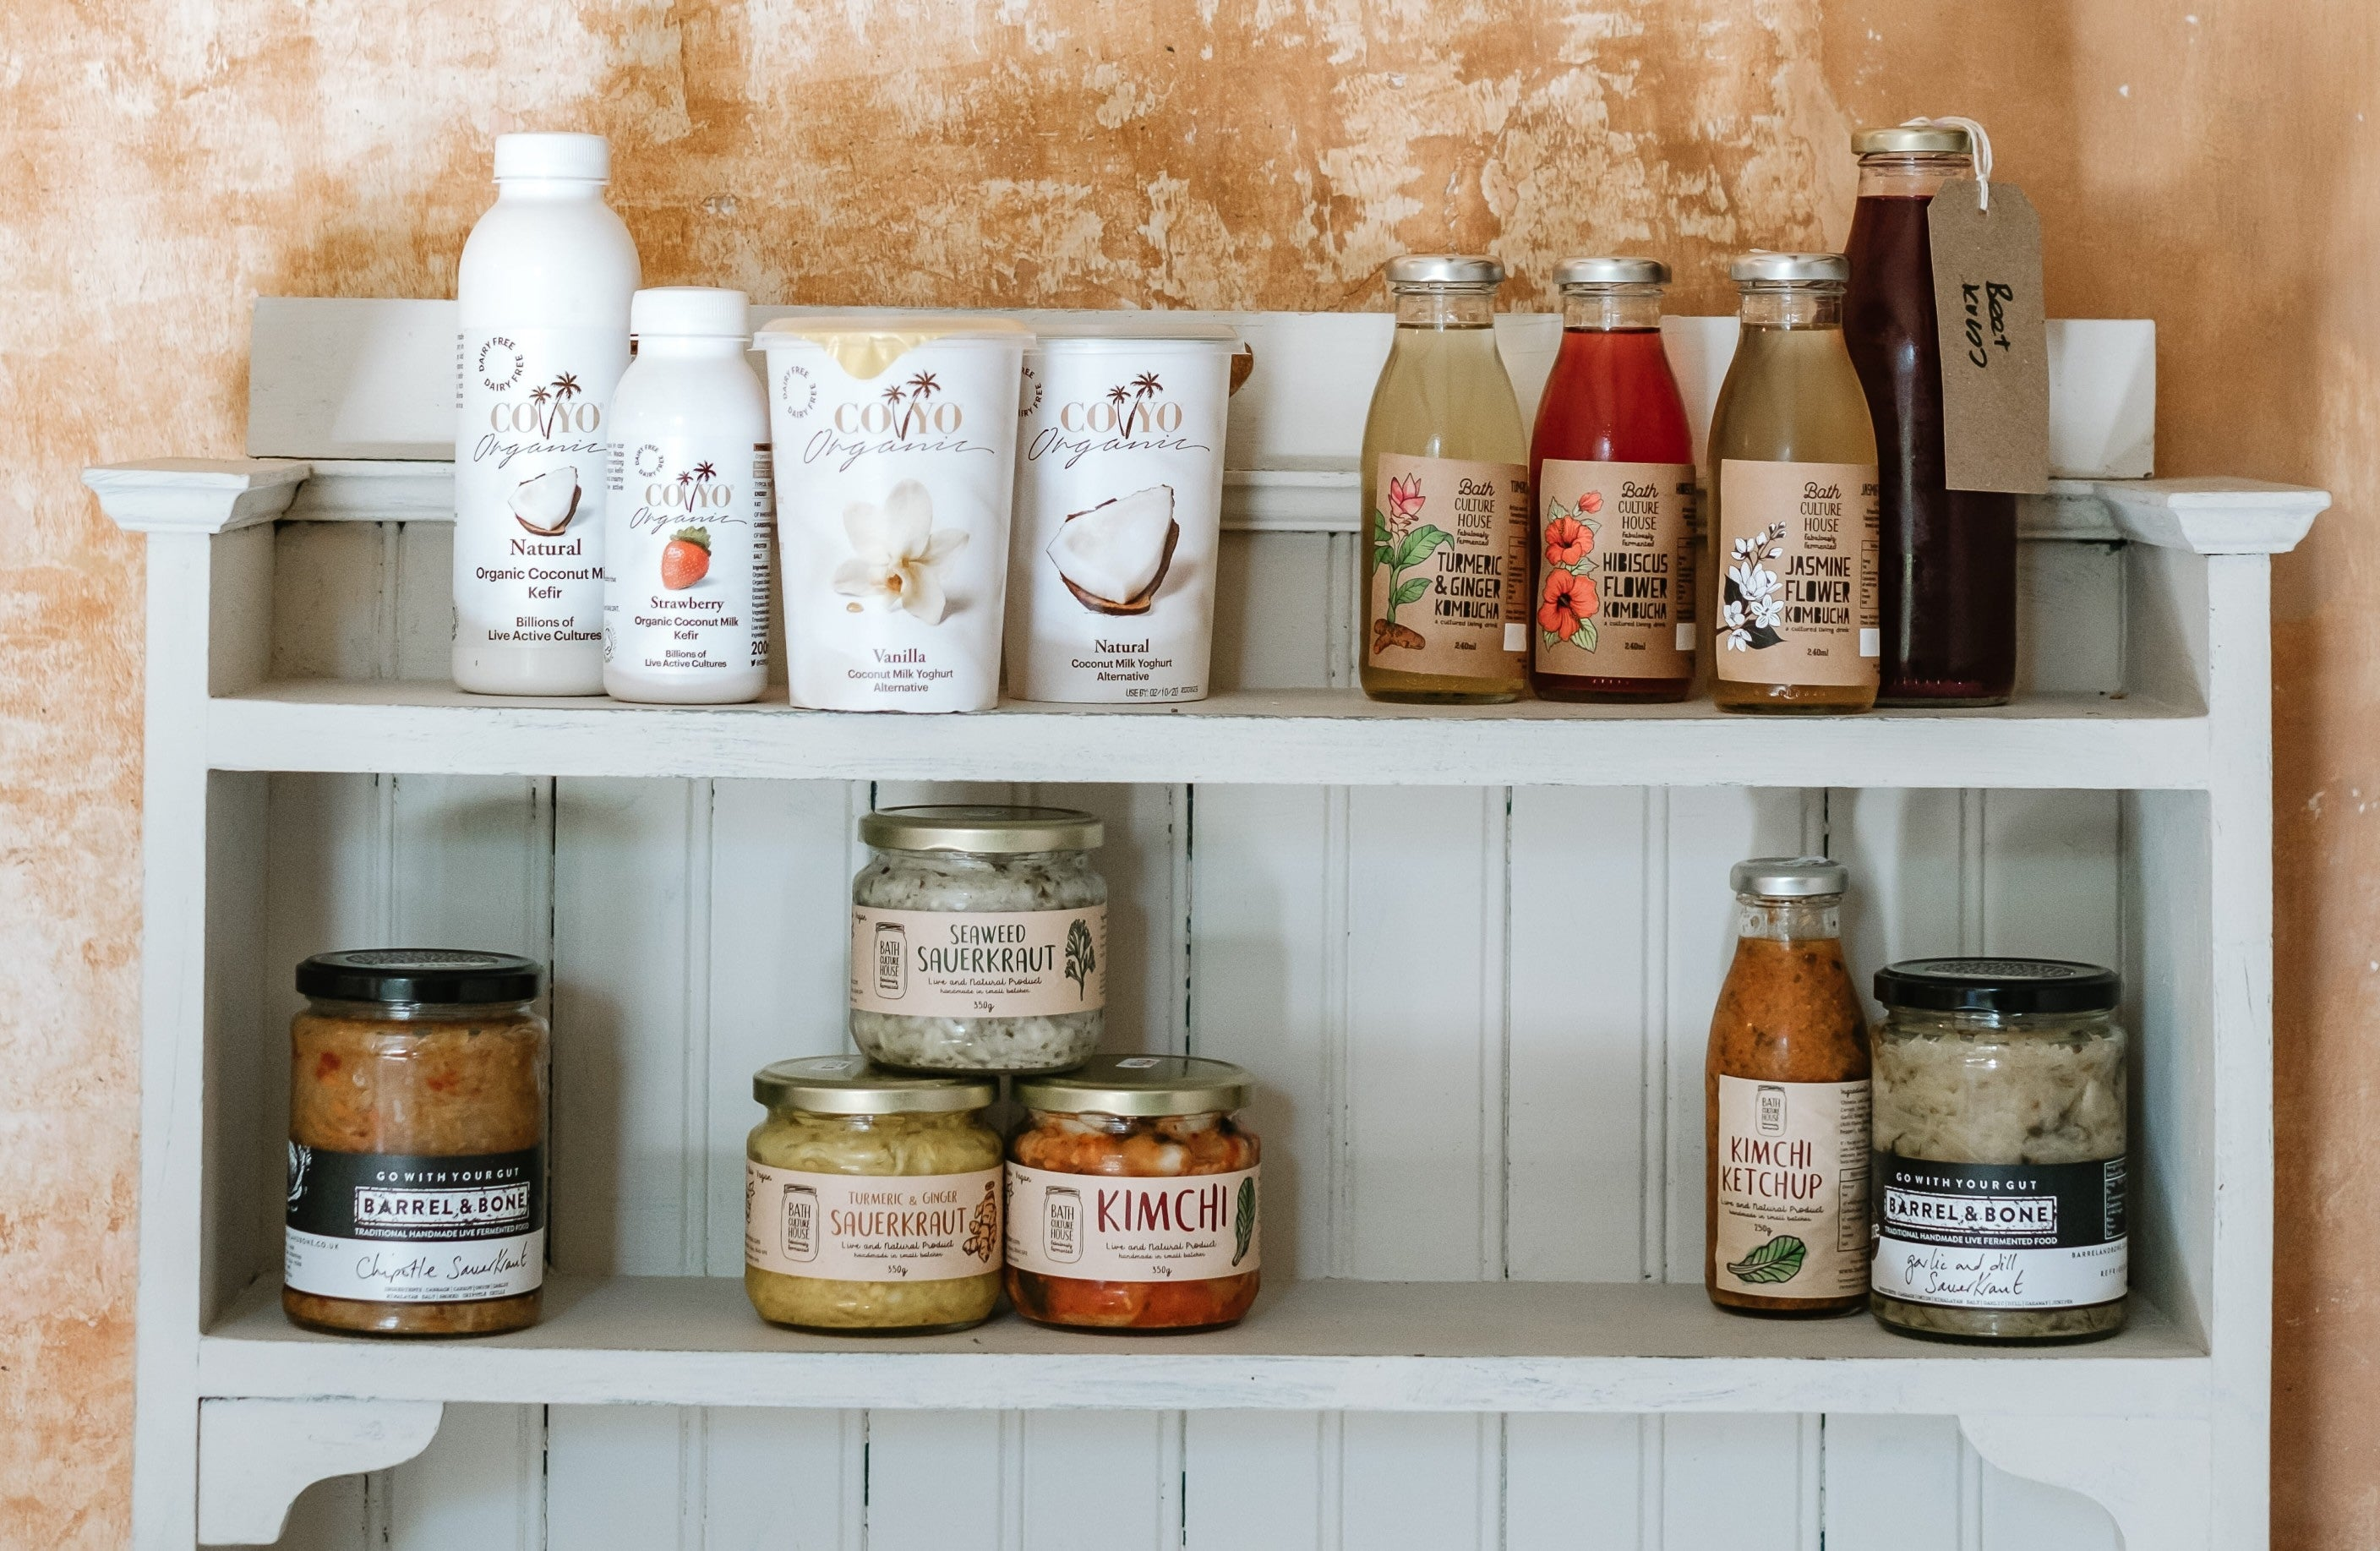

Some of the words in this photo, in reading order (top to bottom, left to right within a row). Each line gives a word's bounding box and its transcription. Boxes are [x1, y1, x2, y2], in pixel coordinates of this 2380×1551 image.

[478, 340, 491, 372] DAIRY
[493, 336, 516, 351] FREE
[484, 378, 511, 391] DAIRY
[510, 354, 523, 382] FREE
[1021, 367, 1035, 380] REE
[783, 372, 791, 400] DAIRY
[792, 366, 810, 380] FREE
[1033, 382, 1043, 409] FREE
[788, 406, 808, 419] DAIRY
[473, 433, 607, 469] Organic
[804, 429, 995, 472] Organic
[1028, 427, 1210, 469] Organic
[1458, 478, 1495, 496] Bath
[1622, 481, 1659, 498] Bath
[1804, 482, 1842, 500] Bath
[1455, 497, 1495, 513] CULTURE
[1619, 500, 1659, 514] CULTURE
[1800, 502, 1842, 516] CULTURE
[630, 506, 747, 534] Organic
[1457, 513, 1492, 529] HOUSE
[1622, 516, 1657, 530] HOUSE
[1804, 517, 1839, 532] HOUSE
[510, 538, 581, 555] Natural
[1438, 551, 1502, 576] TURMERIC
[1603, 552, 1668, 573] HIBISCUS
[1785, 555, 1851, 577] JASMINE
[476, 567, 525, 582] Organic
[528, 567, 588, 580] Coconut
[528, 587, 562, 598] Kefir
[1434, 575, 1447, 595] &
[1450, 576, 1501, 598] GINGER
[1604, 576, 1668, 598] FLOWER
[1785, 580, 1850, 603] FLOWER
[651, 596, 724, 613] Strawberry
[1434, 598, 1499, 620] KOMBUCHA
[1604, 602, 1667, 620] KOMBUCHA
[516, 616, 560, 627] Billions
[562, 616, 574, 627] of
[635, 616, 673, 628] Organic
[674, 617, 718, 626] Coconut
[720, 617, 739, 626] Milk
[1785, 606, 1849, 625] KOMBUCHA
[489, 630, 510, 641] Live
[512, 630, 551, 641] Active
[554, 631, 602, 641] Cultures
[674, 631, 699, 640] Kefir
[1094, 638, 1149, 653] Natural
[1455, 642, 1477, 650] 240ml
[665, 650, 696, 658] Billions
[697, 650, 707, 658] of
[873, 648, 926, 664] Vanilla
[663, 659, 691, 668] Active
[691, 659, 727, 668] Cultures
[1071, 658, 1113, 669] Coconut
[1116, 658, 1136, 668] Milk
[1138, 658, 1173, 669] Yoghurt
[848, 669, 891, 680] Coconut
[892, 669, 914, 679] Milk
[916, 669, 953, 680] Yoghurt
[1097, 671, 1149, 681] Alternative
[874, 682, 929, 692] Alternative
[1126, 687, 1138, 696] USE
[951, 924, 1026, 945] SEAWEED
[880, 941, 900, 956] BATH
[880, 956, 899, 965] CULTURE
[917, 944, 1056, 973] SAUERKRAUT
[880, 965, 899, 976] HOUSE
[928, 977, 947, 986] Live
[969, 977, 1006, 986] Natural
[1008, 976, 1043, 986] Product
[974, 1001, 995, 1013] 350g
[1762, 1097, 1781, 1107] BATH
[1732, 1135, 1811, 1170] KIMCHI
[376, 1171, 397, 1182] GO
[405, 1171, 446, 1182] WITH
[452, 1169, 492, 1182] YOUR
[497, 1167, 519, 1179] GUT
[1896, 1172, 1911, 1182] GO
[1915, 1175, 1950, 1188] WITH
[1956, 1179, 2000, 1190] YOUR
[2006, 1180, 2037, 1190] GUT
[1722, 1166, 1822, 1199] KETCHUP
[364, 1197, 453, 1215] BARREL
[460, 1199, 472, 1215] &
[478, 1192, 527, 1214] BONE
[848, 1191, 903, 1205] TURMERIC
[909, 1194, 917, 1205] &
[922, 1190, 958, 1204] GINGER
[789, 1202, 811, 1218] BATH
[1051, 1204, 1074, 1220] BATH
[1098, 1183, 1227, 1232] KIMCHI
[1753, 1202, 1787, 1213] Natural
[1789, 1205, 1824, 1214] Product
[1890, 1197, 1958, 1221] BARREL
[1964, 1206, 1978, 1221] &
[1984, 1206, 2048, 1223] BONE
[789, 1218, 811, 1228] CULTURE
[831, 1207, 967, 1237] SAUERKRAUT
[1051, 1220, 1073, 1230] CULTURE
[355, 1227, 408, 1238] TRADITIONAL
[409, 1229, 457, 1238] HANDMADE
[459, 1228, 476, 1237] LIVE
[477, 1225, 515, 1237] FERMENTED
[515, 1223, 529, 1232] FOOD
[789, 1227, 810, 1240] HOUSE
[1051, 1229, 1073, 1241] HOUSE
[1885, 1226, 1919, 1239] TRADITIONAL
[1920, 1232, 1963, 1244] HANDMADE
[1965, 1236, 1982, 1244] LIVE
[1984, 1237, 2033, 1245] FERMENTED
[2034, 1237, 2057, 1245] FOOD
[864, 1242, 882, 1250] and
[884, 1242, 919, 1250] Natural
[922, 1240, 953, 1248] Product
[1128, 1242, 1146, 1251] and
[1149, 1242, 1184, 1251] Natural
[1186, 1240, 1217, 1249] Product
[356, 1253, 437, 1283] Chipotle
[888, 1264, 908, 1277] 350g
[1152, 1265, 1172, 1277] 350g
[1906, 1248, 1947, 1285] garlic
[1955, 1253, 1985, 1271] and
[1990, 1253, 2017, 1271] dill
